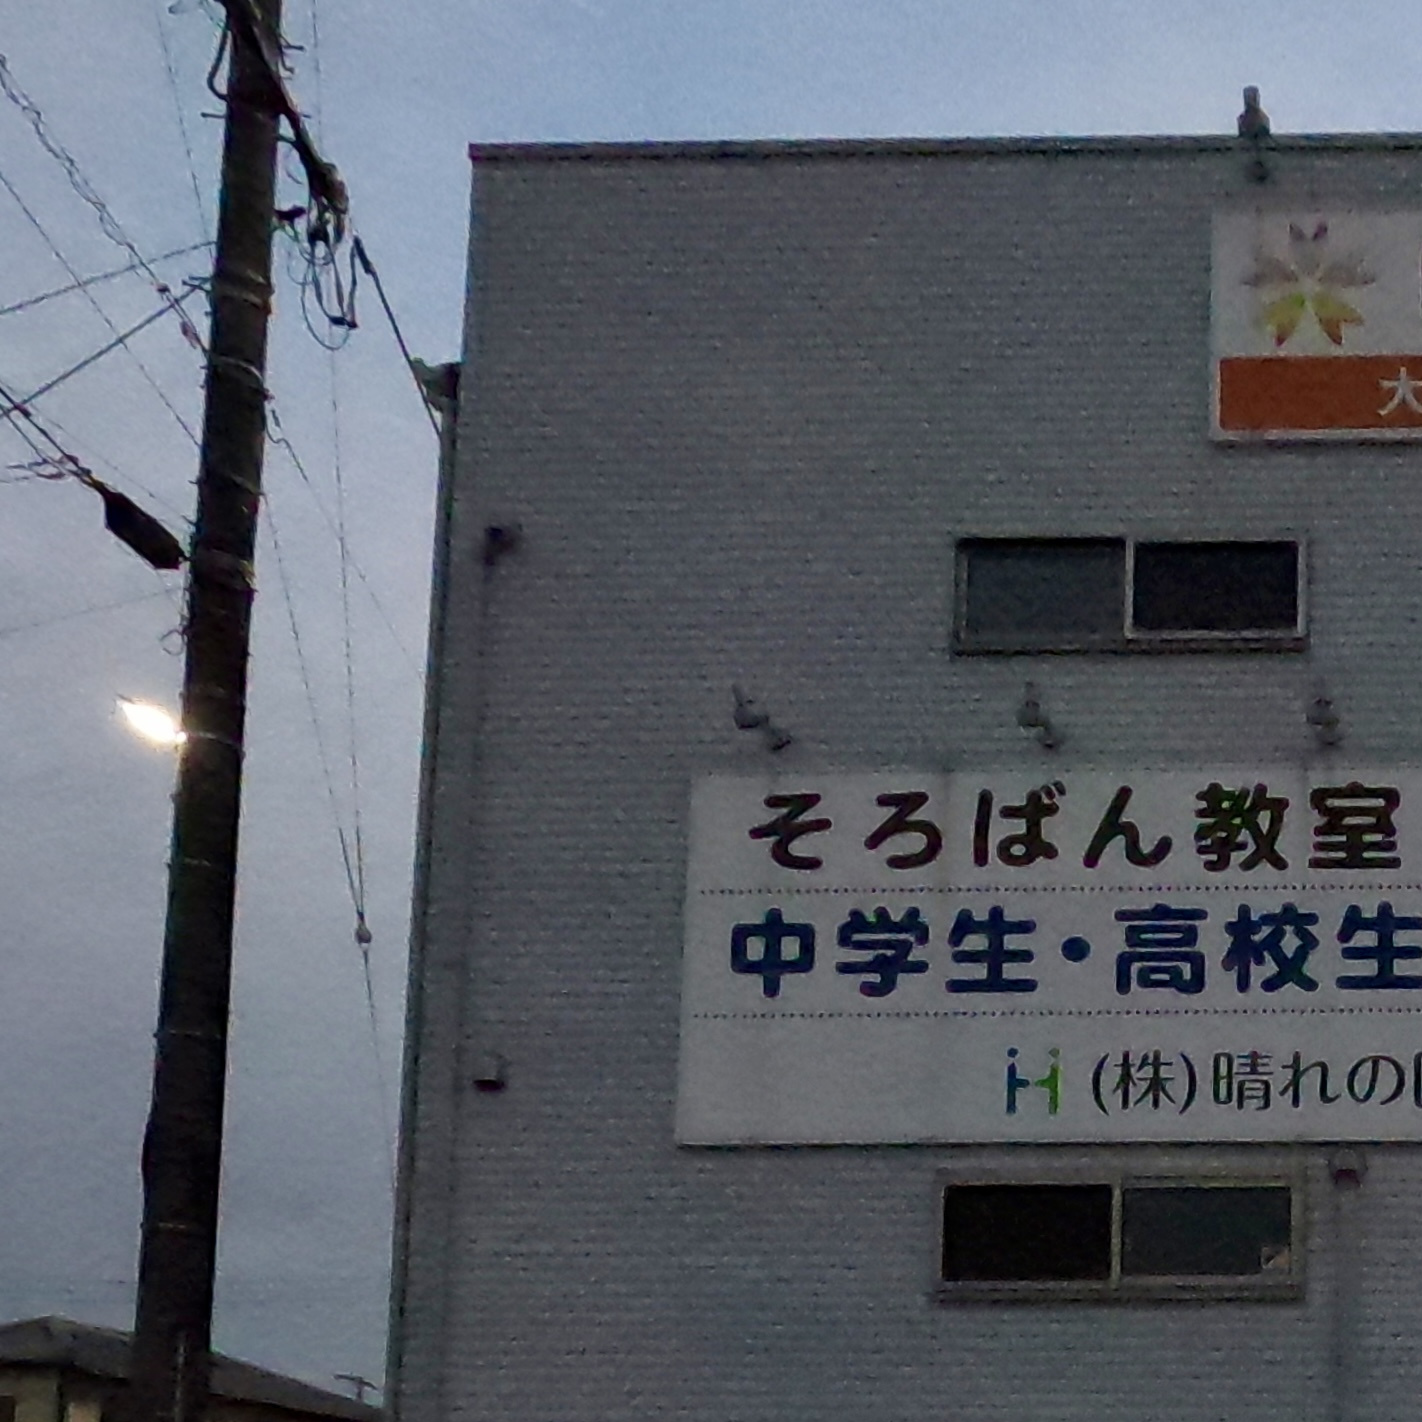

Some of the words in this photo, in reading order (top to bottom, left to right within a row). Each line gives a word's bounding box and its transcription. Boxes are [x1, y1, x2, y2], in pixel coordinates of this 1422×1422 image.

[748, 781, 1402, 871] そろばん教室
